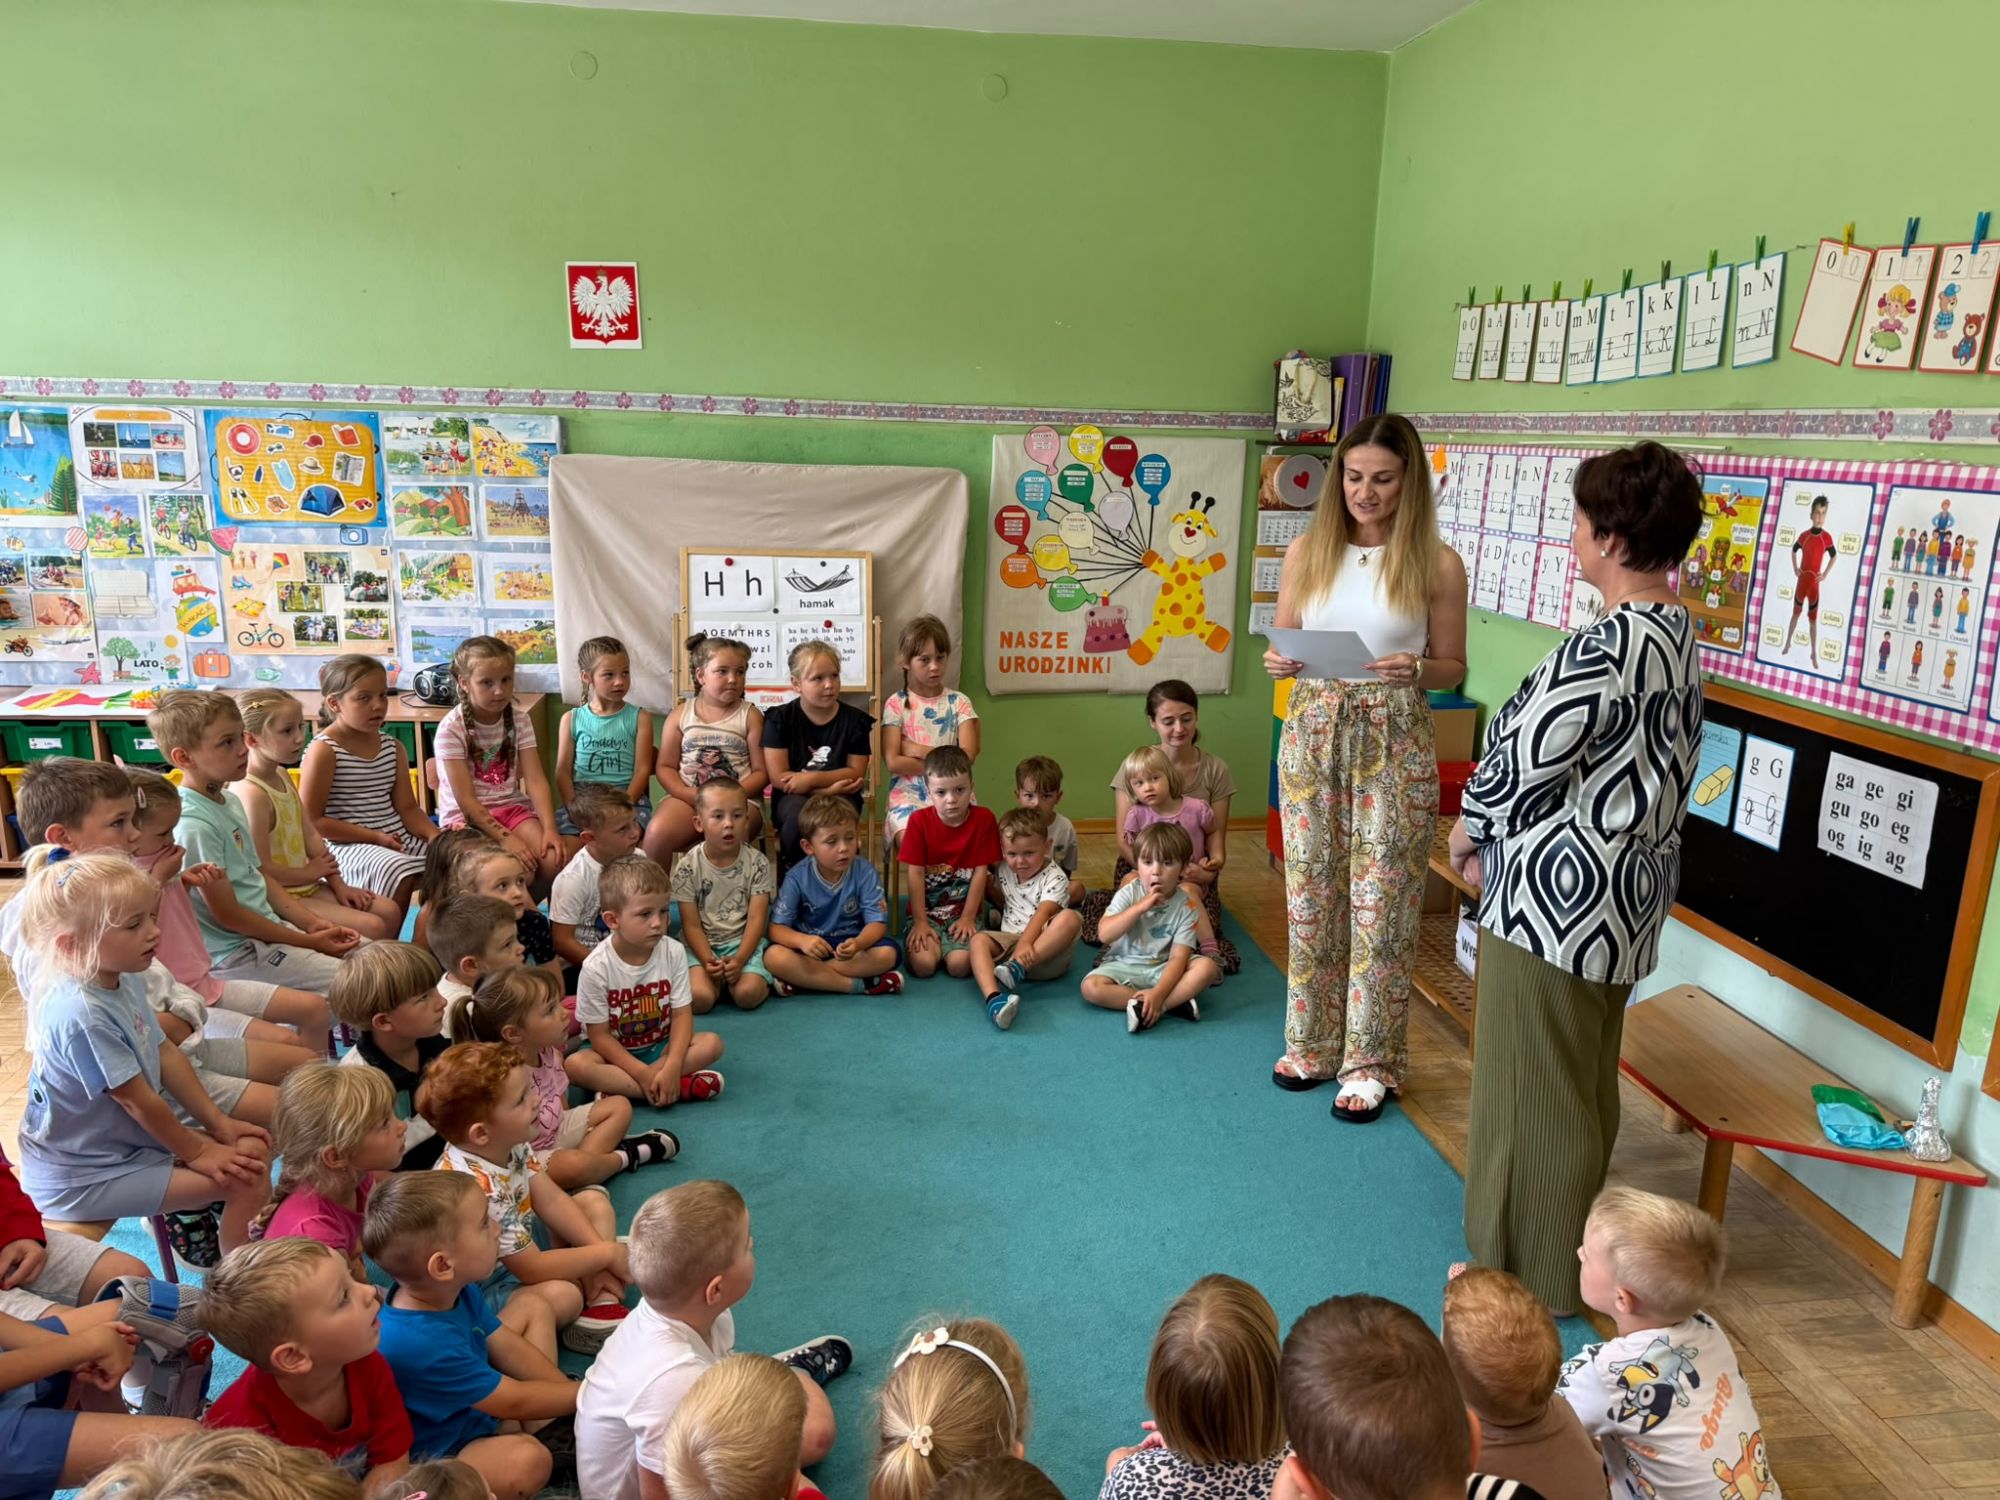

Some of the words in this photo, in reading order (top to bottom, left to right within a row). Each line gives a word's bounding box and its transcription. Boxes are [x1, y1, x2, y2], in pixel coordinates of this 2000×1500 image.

[704, 570, 724, 597] H
[745, 569, 762, 597] h
[799, 598, 835, 609] hamak
[999, 631, 1069, 649] NASZE
[134, 660, 159, 668] LATO
[998, 655, 1111, 674] URODZINKI
[1750, 757, 1760, 775] g
[1770, 758, 1783, 779] G
[1835, 772, 1854, 791] ga
[1865, 781, 1884, 801] ge
[1897, 790, 1914, 812] gi
[1830, 800, 1850, 819] gu
[1859, 810, 1879, 830] go
[1891, 821, 1911, 844] eg
[1827, 829, 1846, 851] og
[1858, 835, 1873, 861] ig
[1885, 850, 1906, 874] ag
